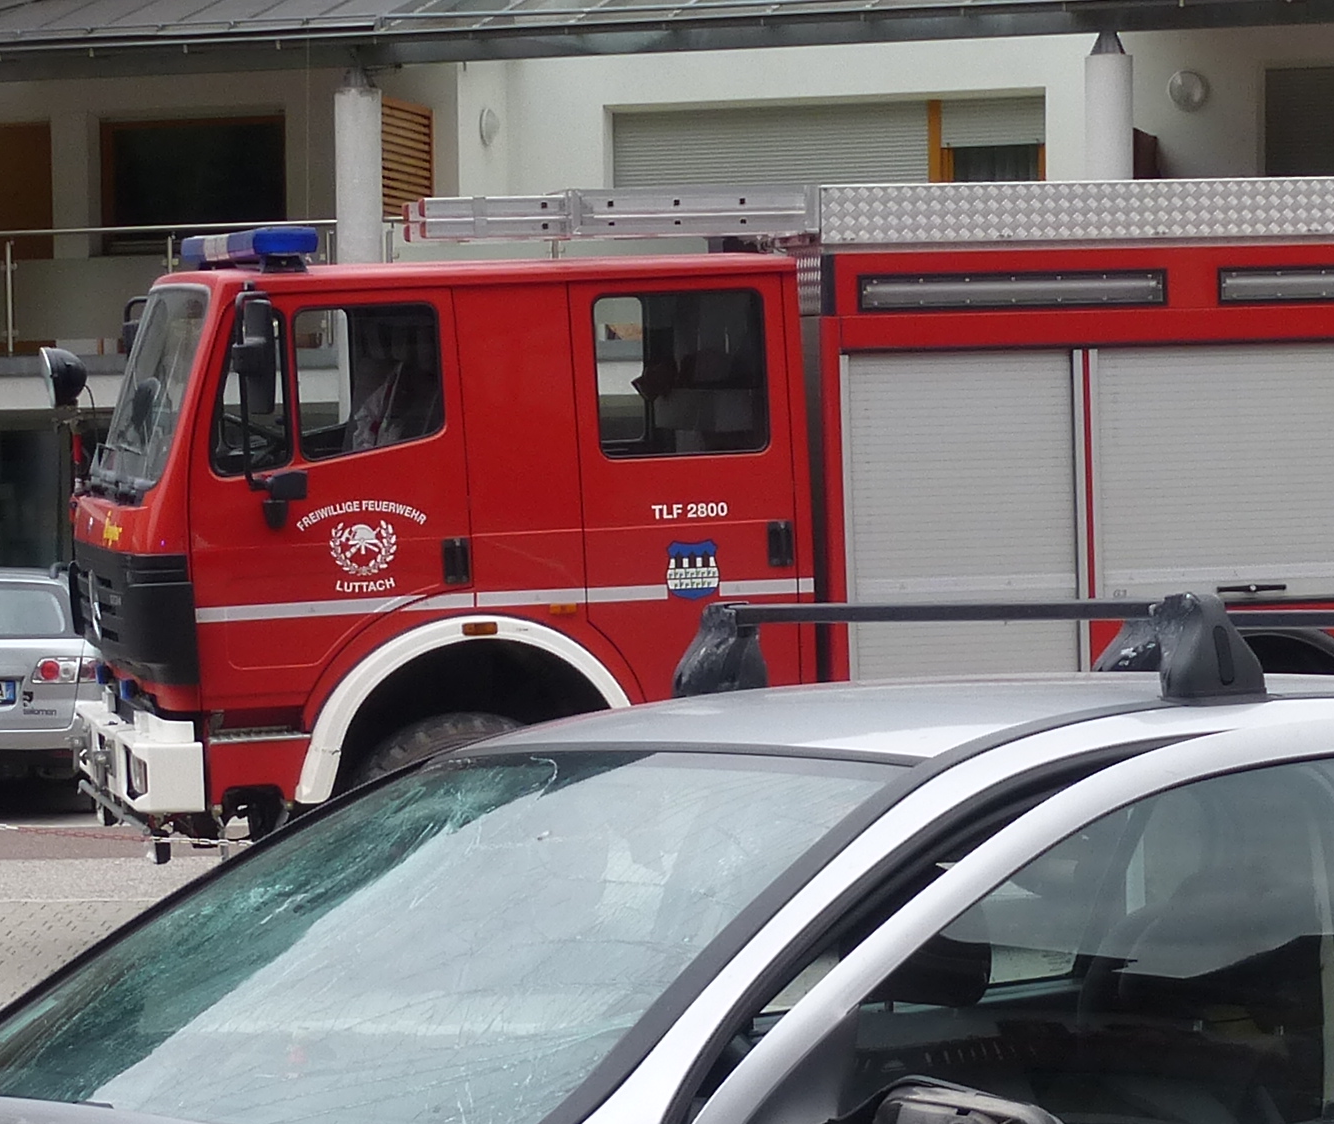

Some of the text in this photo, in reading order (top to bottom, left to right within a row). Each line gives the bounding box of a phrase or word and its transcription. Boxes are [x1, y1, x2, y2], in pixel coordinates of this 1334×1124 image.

[296, 500, 427, 532] FREIWILLIGE FEUERWEHR
[651, 502, 728, 519] TLF 2800
[335, 576, 396, 593] LUTTACH
